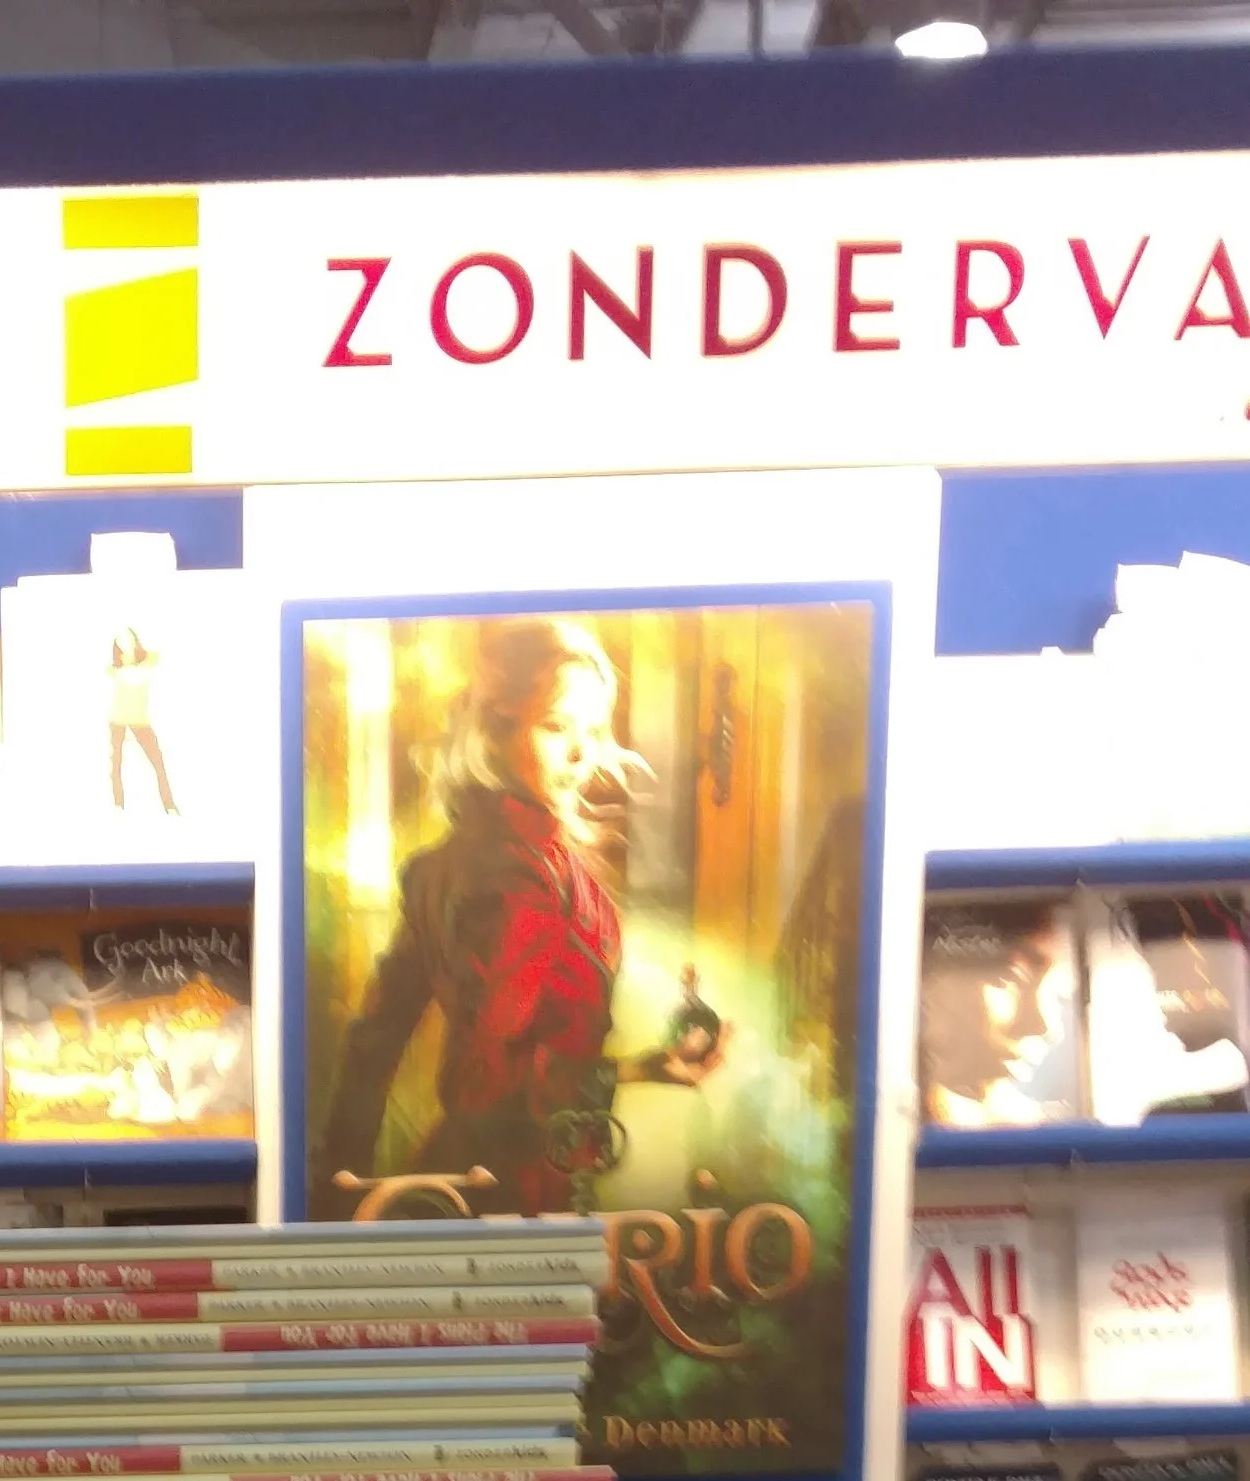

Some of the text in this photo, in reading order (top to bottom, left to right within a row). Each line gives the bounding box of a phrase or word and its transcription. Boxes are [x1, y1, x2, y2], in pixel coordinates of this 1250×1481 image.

[92, 926, 244, 973] Goodnight
[141, 956, 187, 986] Ark
[4, 1262, 14, 1289] I
[21, 1262, 68, 1289] Have
[75, 1259, 109, 1288] for
[115, 1262, 152, 1288] You
[6, 1295, 53, 1323] Have
[61, 1292, 93, 1322] for
[102, 1294, 138, 1321] You
[602, 1413, 794, 1451] Denmark
